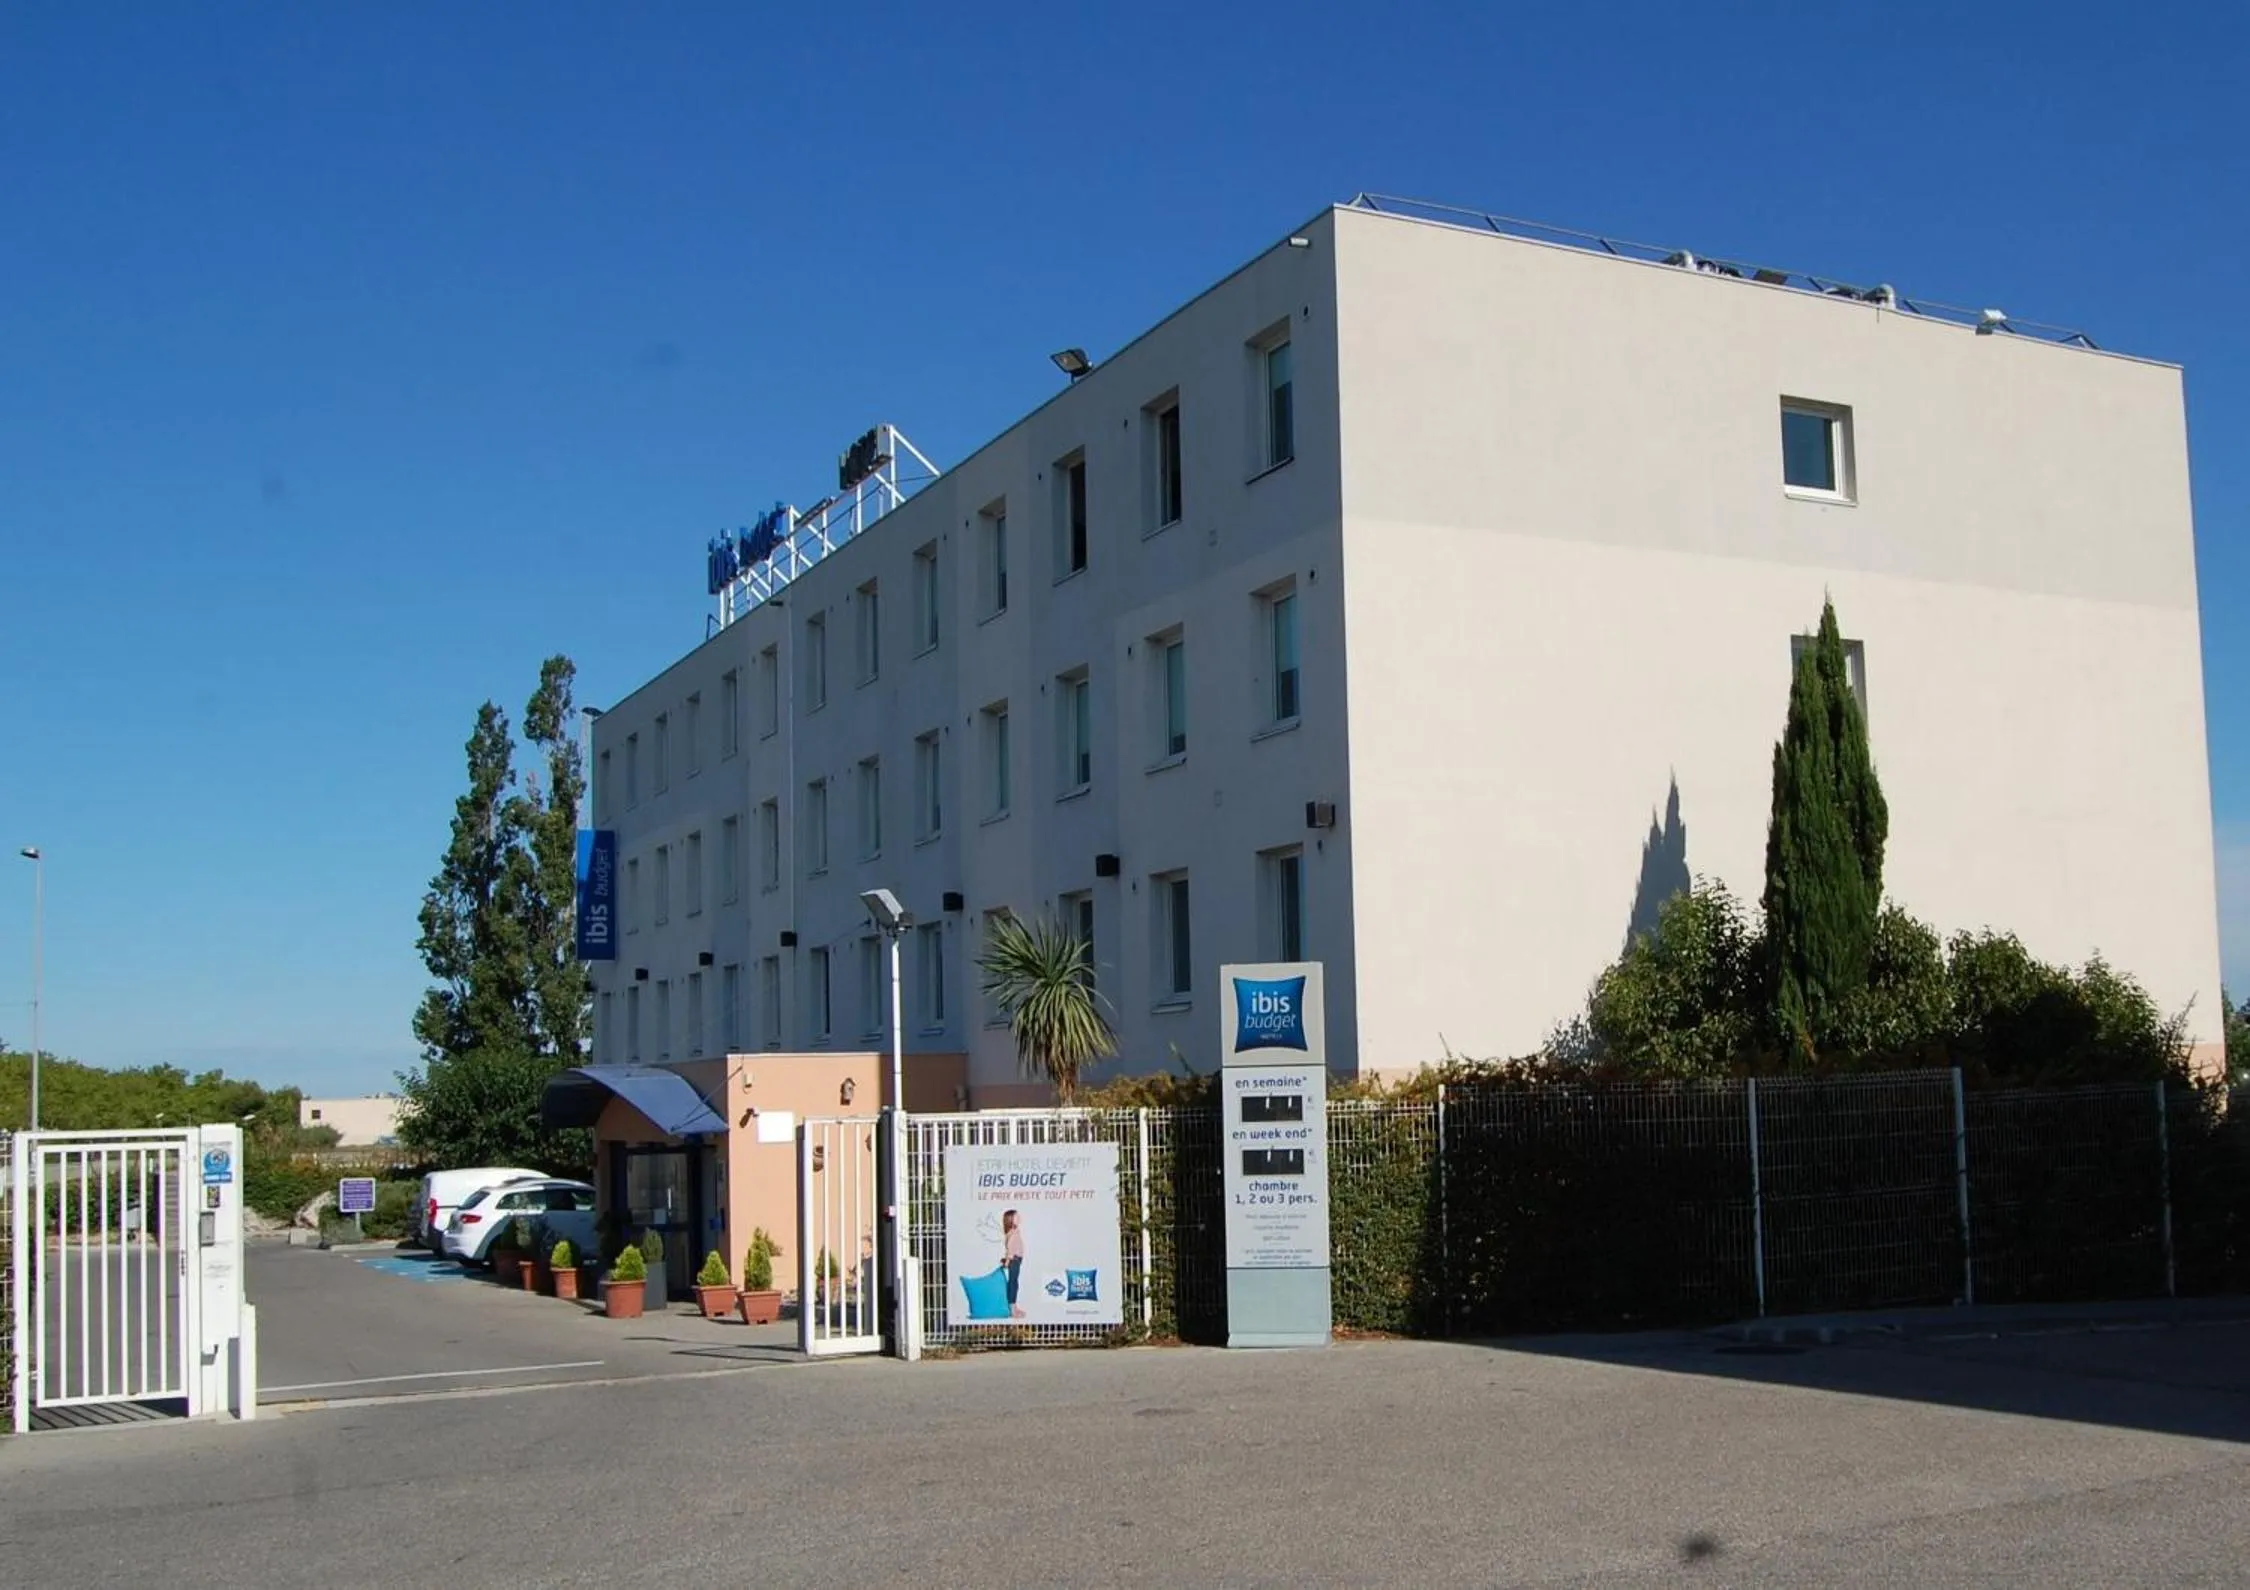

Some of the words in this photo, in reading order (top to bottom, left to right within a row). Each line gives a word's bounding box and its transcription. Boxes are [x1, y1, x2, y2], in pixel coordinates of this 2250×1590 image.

[585, 904, 608, 944] ibis
[1252, 991, 1290, 1014] ibis
[1244, 1013, 1297, 1032] budget
[1235, 1080, 1249, 1088] en
[1232, 1131, 1246, 1139] en
[1250, 1128, 1281, 1139] week
[978, 1174, 1005, 1187] IBIS
[1009, 1172, 1067, 1187] BUDGET
[1249, 1180, 1299, 1191] chambre
[1044, 1190, 1067, 1200] TOUT
[1249, 1193, 1257, 1204] 2
[1259, 1195, 1274, 1204] ou
[1278, 1194, 1285, 1204] 3
[1288, 1194, 1318, 1206] pers.
